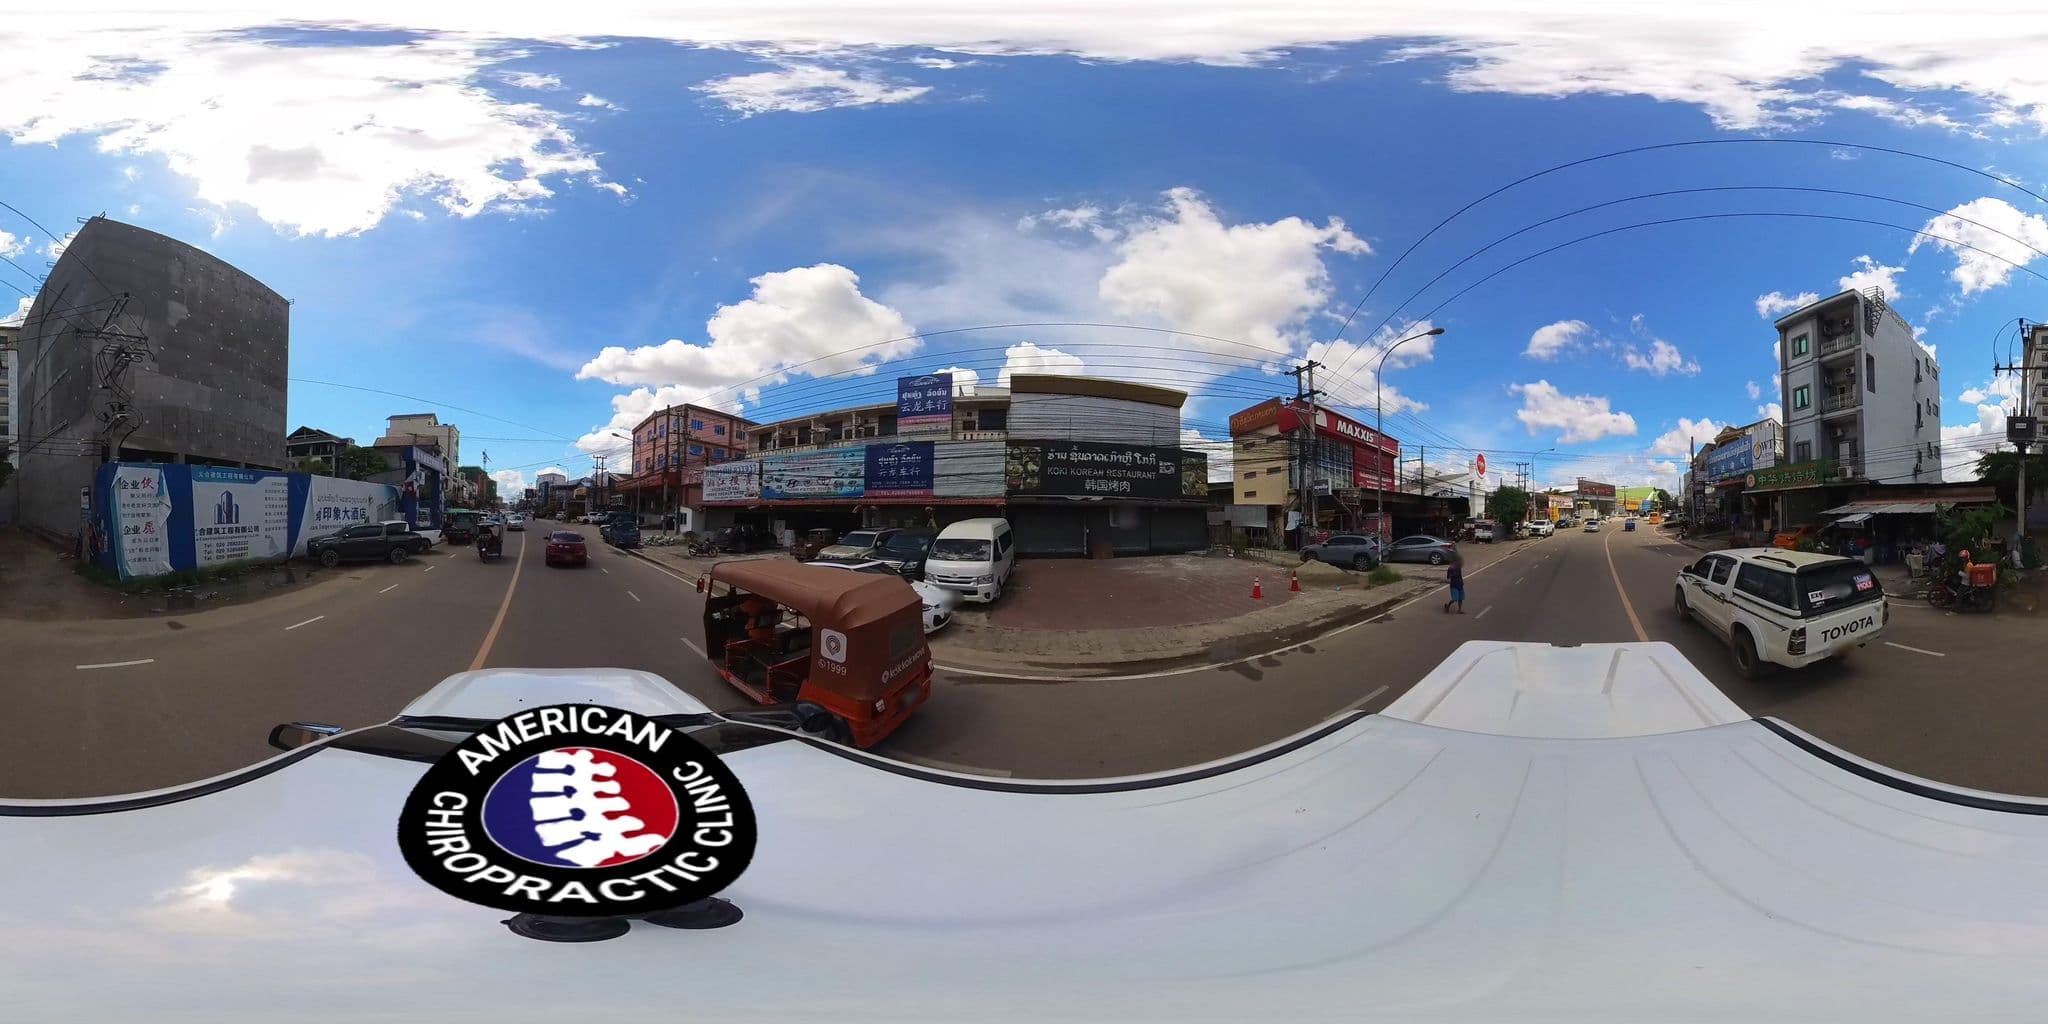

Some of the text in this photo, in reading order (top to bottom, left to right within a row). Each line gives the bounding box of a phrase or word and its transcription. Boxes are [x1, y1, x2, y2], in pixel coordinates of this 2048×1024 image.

[1337, 420, 1374, 443] MAXXIS
[1106, 469, 1156, 480] RESTAURANT
[1084, 479, 1131, 492] 韩国烤肉
[1821, 616, 1873, 643] TOYOTA
[826, 661, 847, 676] 1999
